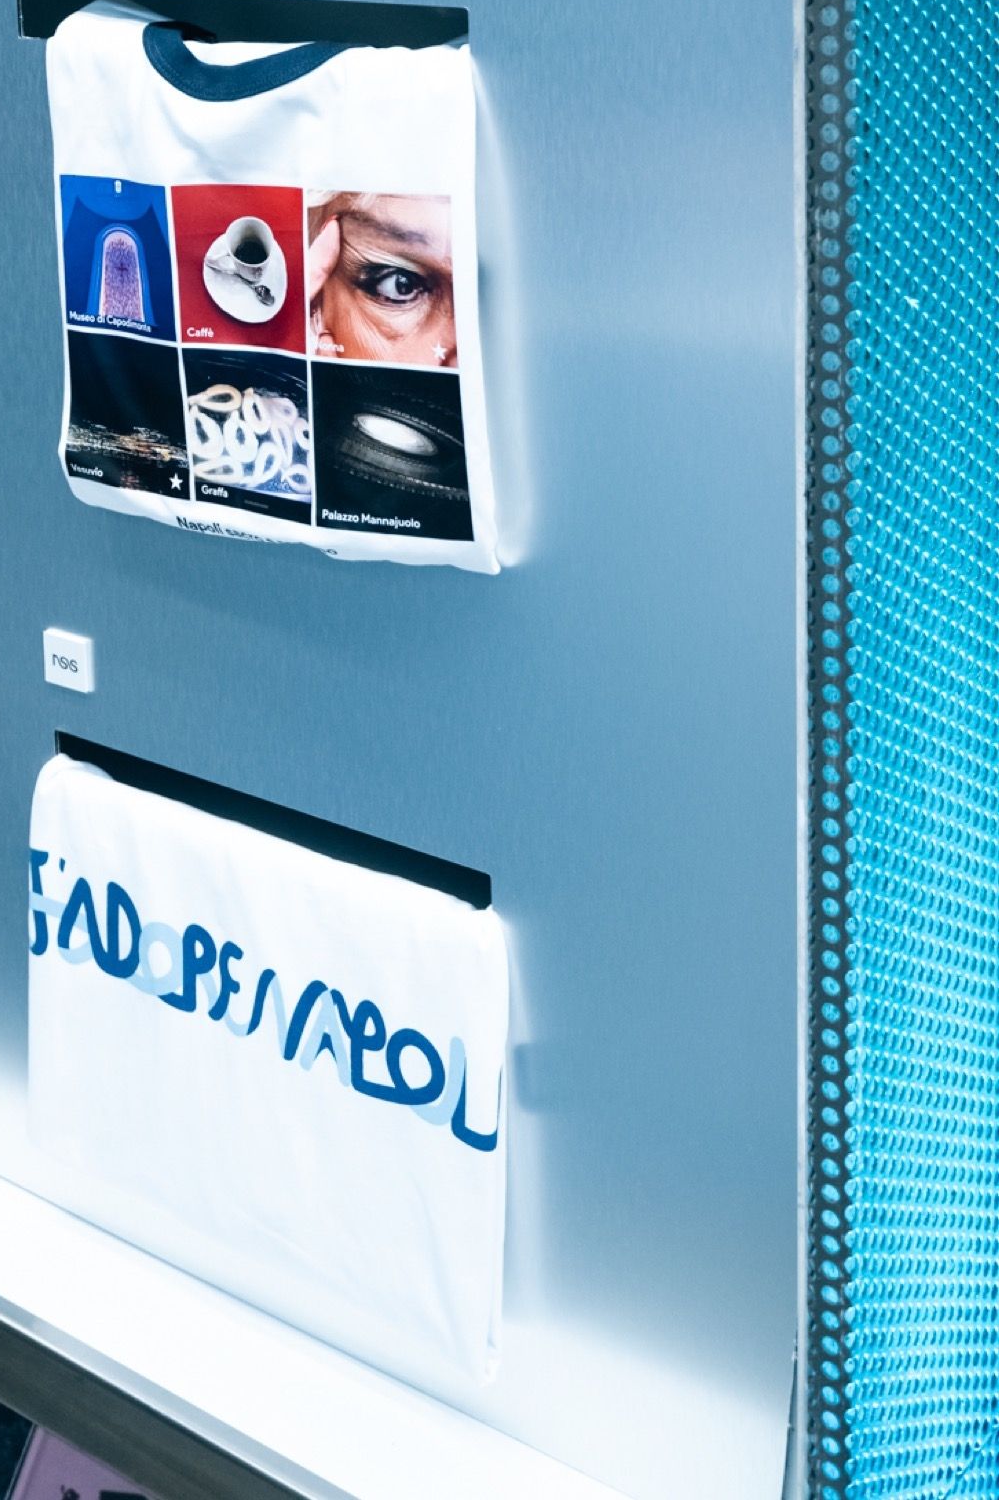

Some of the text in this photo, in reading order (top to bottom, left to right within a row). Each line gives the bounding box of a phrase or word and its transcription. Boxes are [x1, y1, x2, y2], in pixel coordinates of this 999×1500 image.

[69, 310, 95, 323] Museo
[96, 313, 105, 324] di
[201, 483, 229, 499] Graffa
[175, 515, 224, 535] Napoli
[321, 508, 421, 530] Palazzo Mannajuolo
